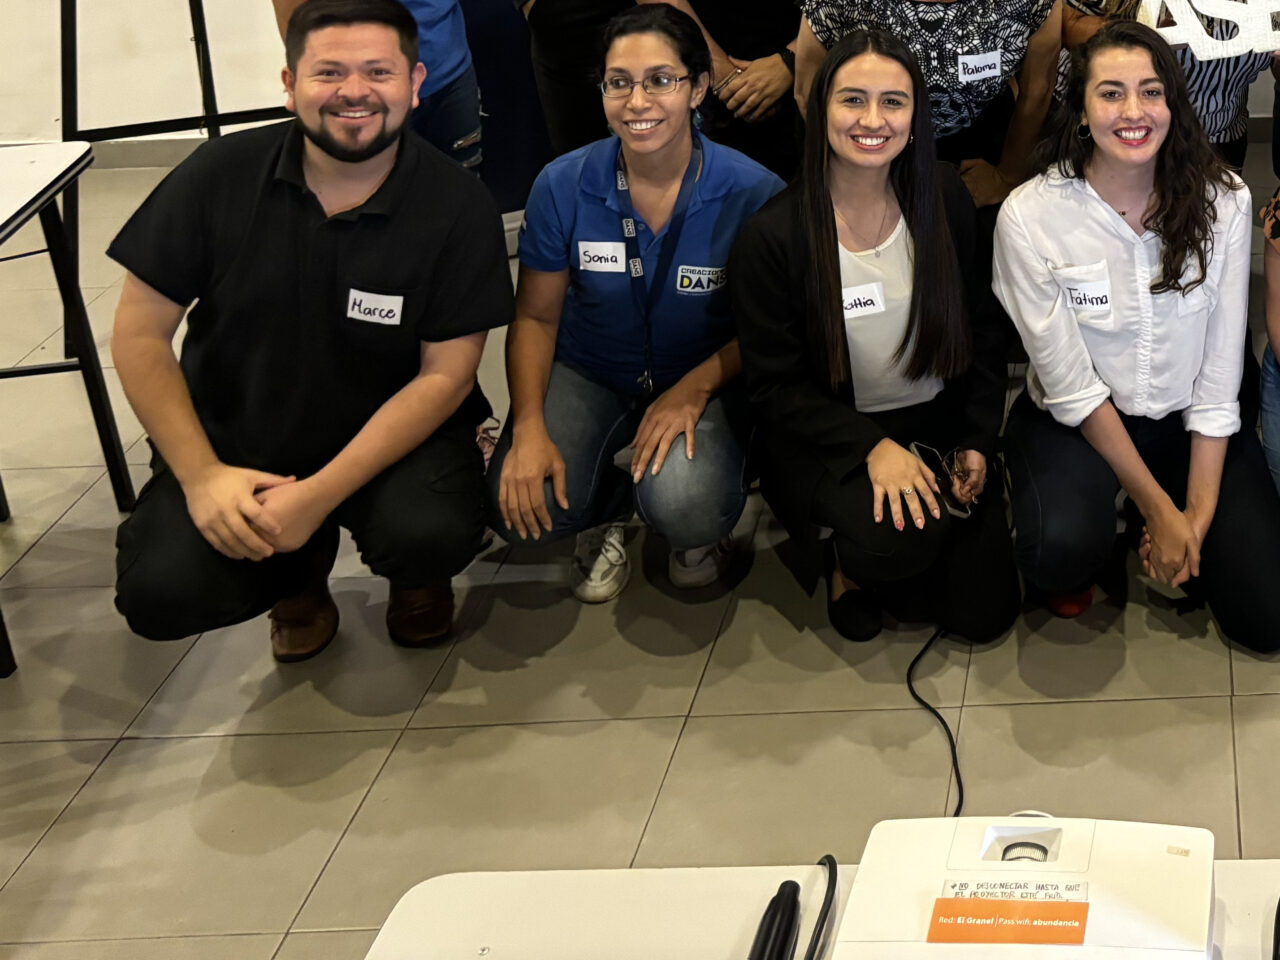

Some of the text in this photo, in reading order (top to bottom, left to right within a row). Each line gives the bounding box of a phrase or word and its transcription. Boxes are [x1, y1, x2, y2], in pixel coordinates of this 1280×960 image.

[961, 61, 997, 76] Paloma
[583, 250, 618, 264] Sonia
[938, 916, 955, 924] Red:
[956, 916, 965, 924] El
[998, 917, 1015, 926] Pass
[1032, 918, 1080, 927] abundancia
